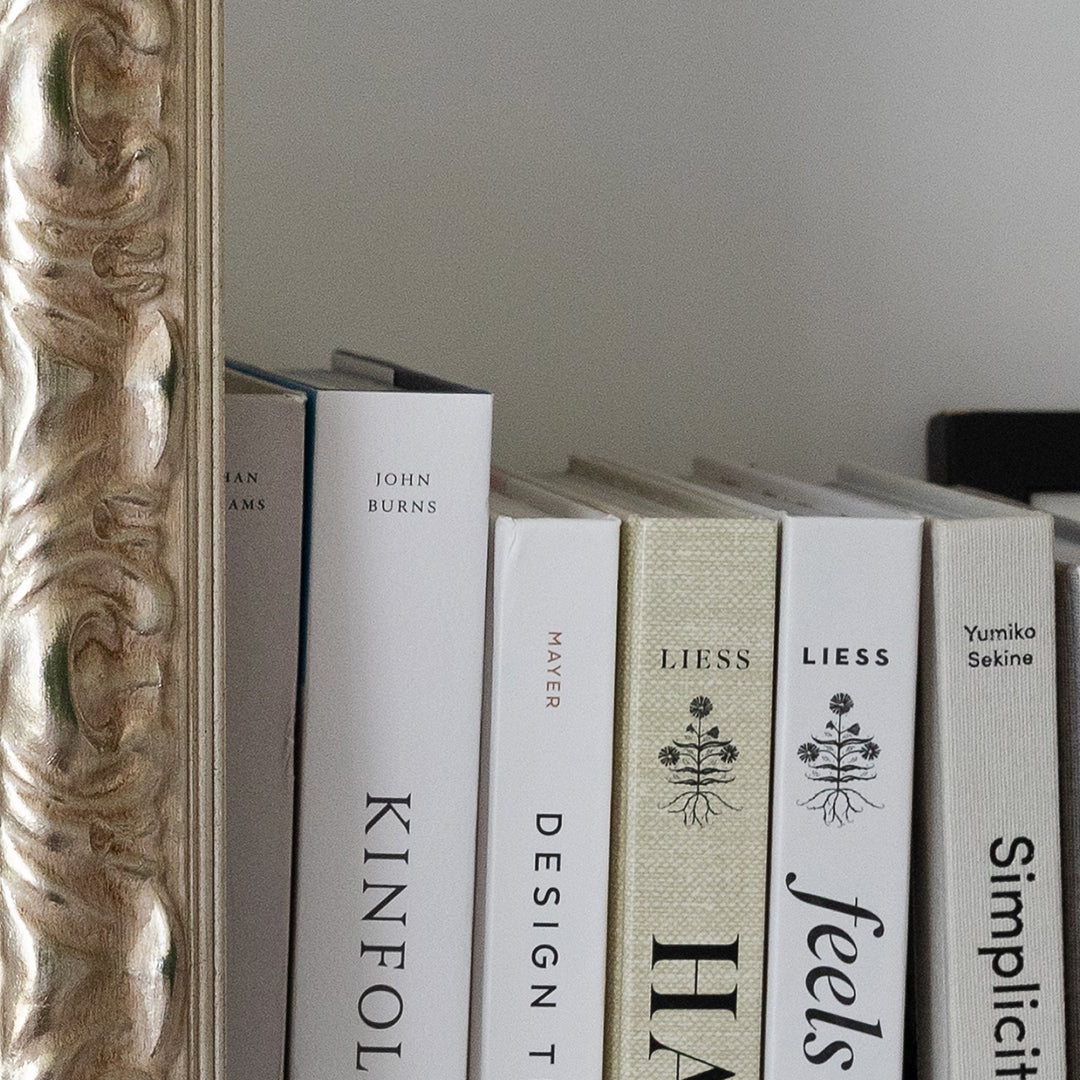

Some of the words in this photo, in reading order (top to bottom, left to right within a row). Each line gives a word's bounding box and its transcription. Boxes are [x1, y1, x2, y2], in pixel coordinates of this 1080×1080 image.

[376, 472, 430, 487] JOHN
[228, 499, 265, 511] AMS
[368, 500, 436, 514] BURNS
[964, 623, 1036, 642] Yumiko
[661, 648, 750, 670] LIESS
[802, 647, 889, 667] LIESS
[968, 650, 1033, 668] Sekine
[545, 631, 563, 708] MAYER
[530, 813, 563, 1008] DESIGN
[785, 871, 885, 1071] feels
